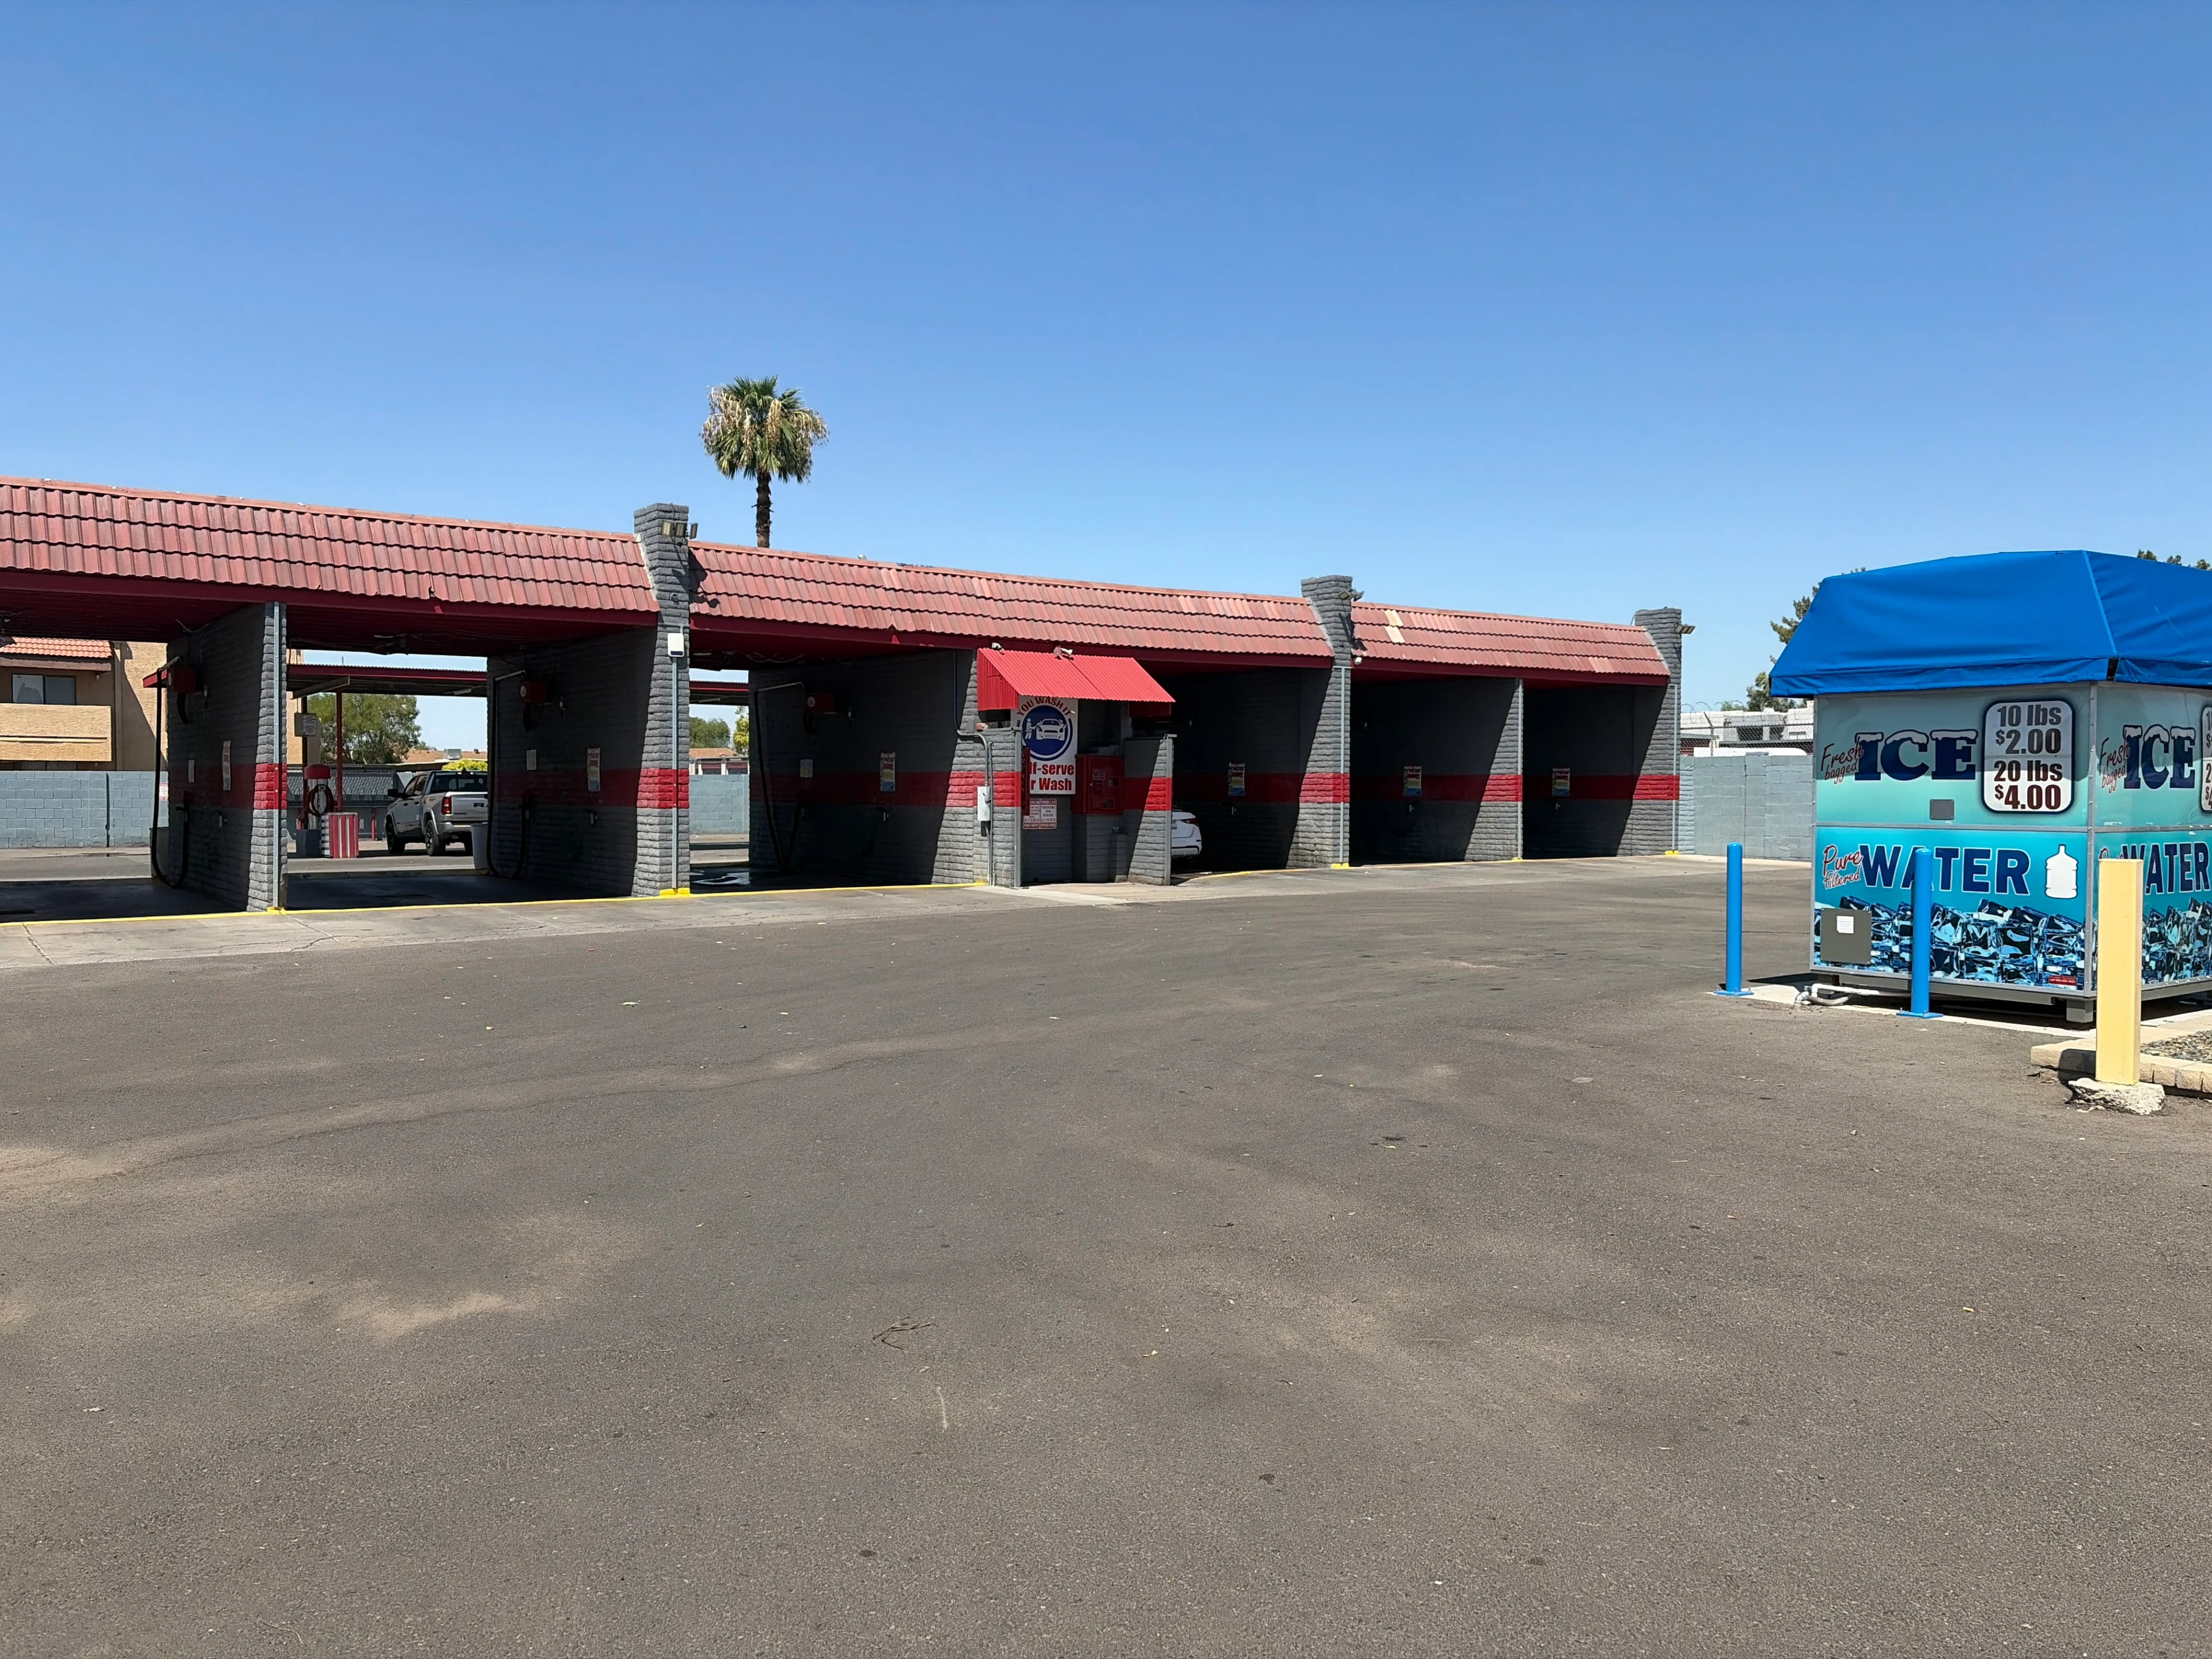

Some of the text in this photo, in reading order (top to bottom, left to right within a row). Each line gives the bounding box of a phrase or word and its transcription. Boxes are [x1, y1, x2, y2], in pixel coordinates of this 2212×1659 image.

[1017, 696, 1071, 716] YOU WASH IT
[1997, 704, 2061, 727] 10 lbs
[2206, 710, 2212, 731] 1
[1821, 736, 1864, 772] Fresh
[1995, 728, 2062, 755] $2.00
[2099, 729, 2130, 776] Fresh
[1854, 729, 1979, 781] ICE
[2123, 724, 2196, 790] ICE
[1029, 762, 1074, 775] lf-serve
[1824, 757, 1858, 784] bagged
[1994, 760, 2063, 782] 20 lbs
[2101, 765, 2126, 794] bagged
[2205, 763, 2212, 783] 2
[1039, 778, 1072, 791] Wash
[1994, 784, 2061, 810] $4.00
[1823, 844, 1863, 876] Pure
[1823, 864, 1861, 890] filtered
